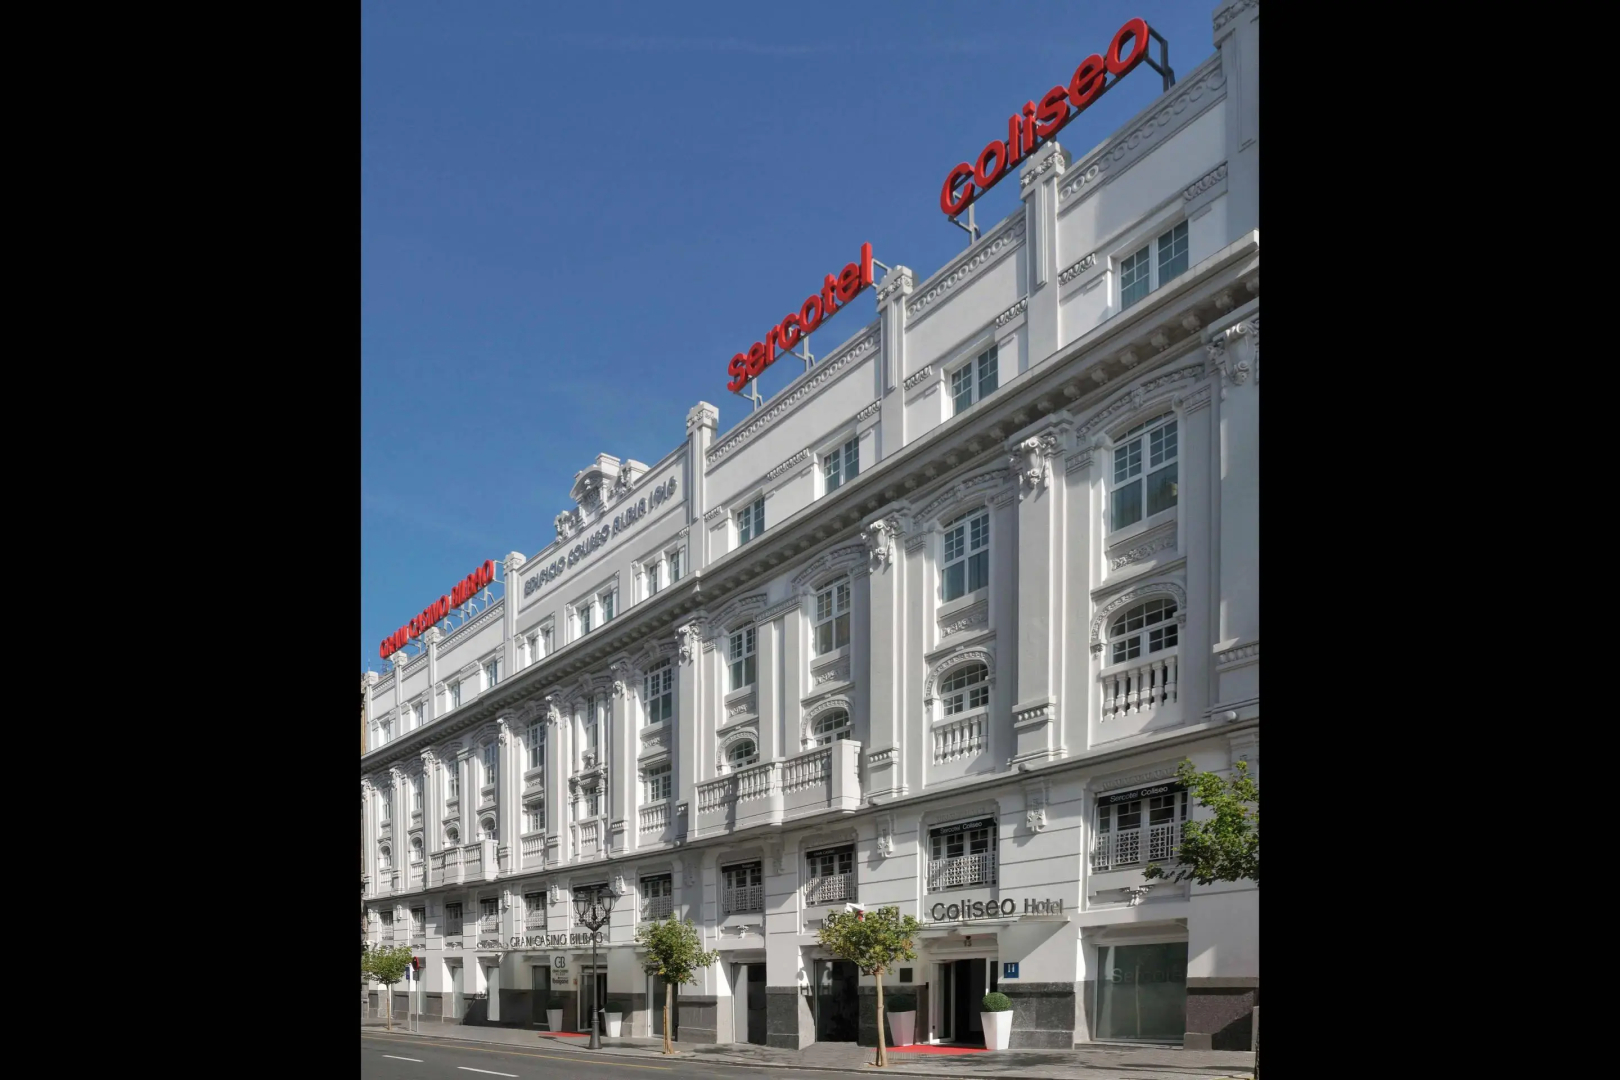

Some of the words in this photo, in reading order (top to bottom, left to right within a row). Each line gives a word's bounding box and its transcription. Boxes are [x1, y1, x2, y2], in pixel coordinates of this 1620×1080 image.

[380, 625, 409, 659] GRAN
[409, 595, 450, 638] CASINO
[451, 560, 494, 609] BILBAO
[1110, 791, 1138, 803] Sercotel
[1140, 785, 1169, 797] Coliseo
[962, 820, 983, 830] Coliseo
[931, 898, 1015, 921] Coliseo
[1024, 898, 1064, 915] Hotel
[510, 936, 532, 948] GRAN
[534, 933, 567, 946] CASINO
[570, 931, 603, 945] BILBAO
